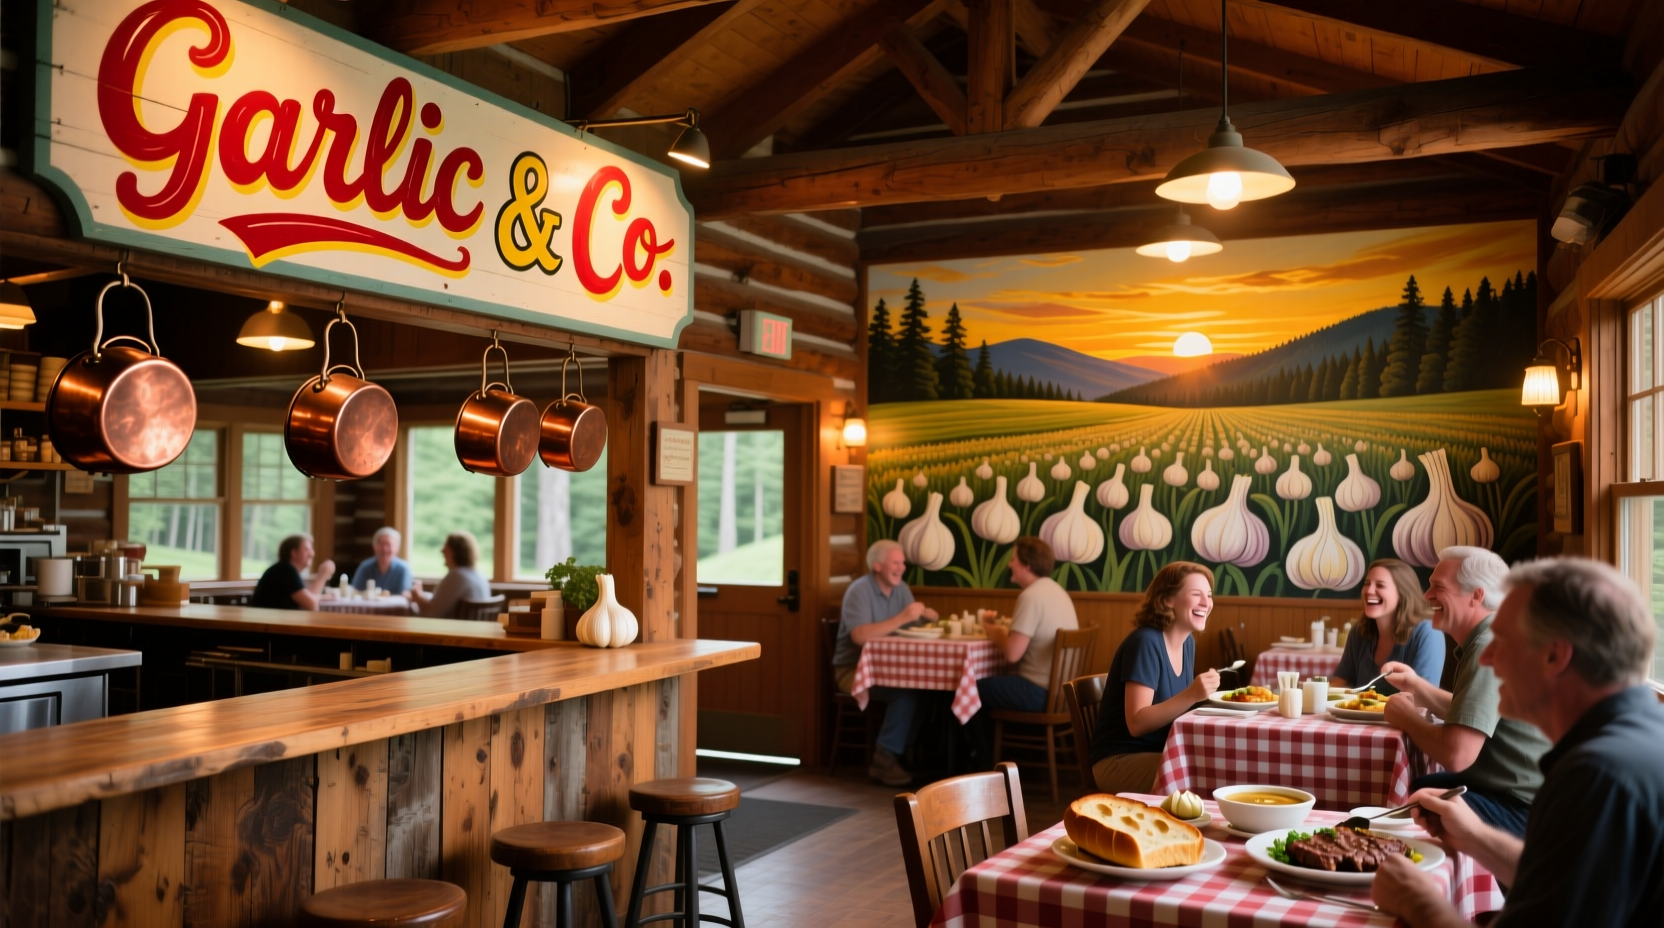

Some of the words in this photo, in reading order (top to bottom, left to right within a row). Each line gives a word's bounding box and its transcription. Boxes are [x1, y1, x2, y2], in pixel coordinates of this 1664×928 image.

[98, 0, 485, 236] Garlic
[495, 150, 563, 275] &
[572, 165, 675, 298] Co.
